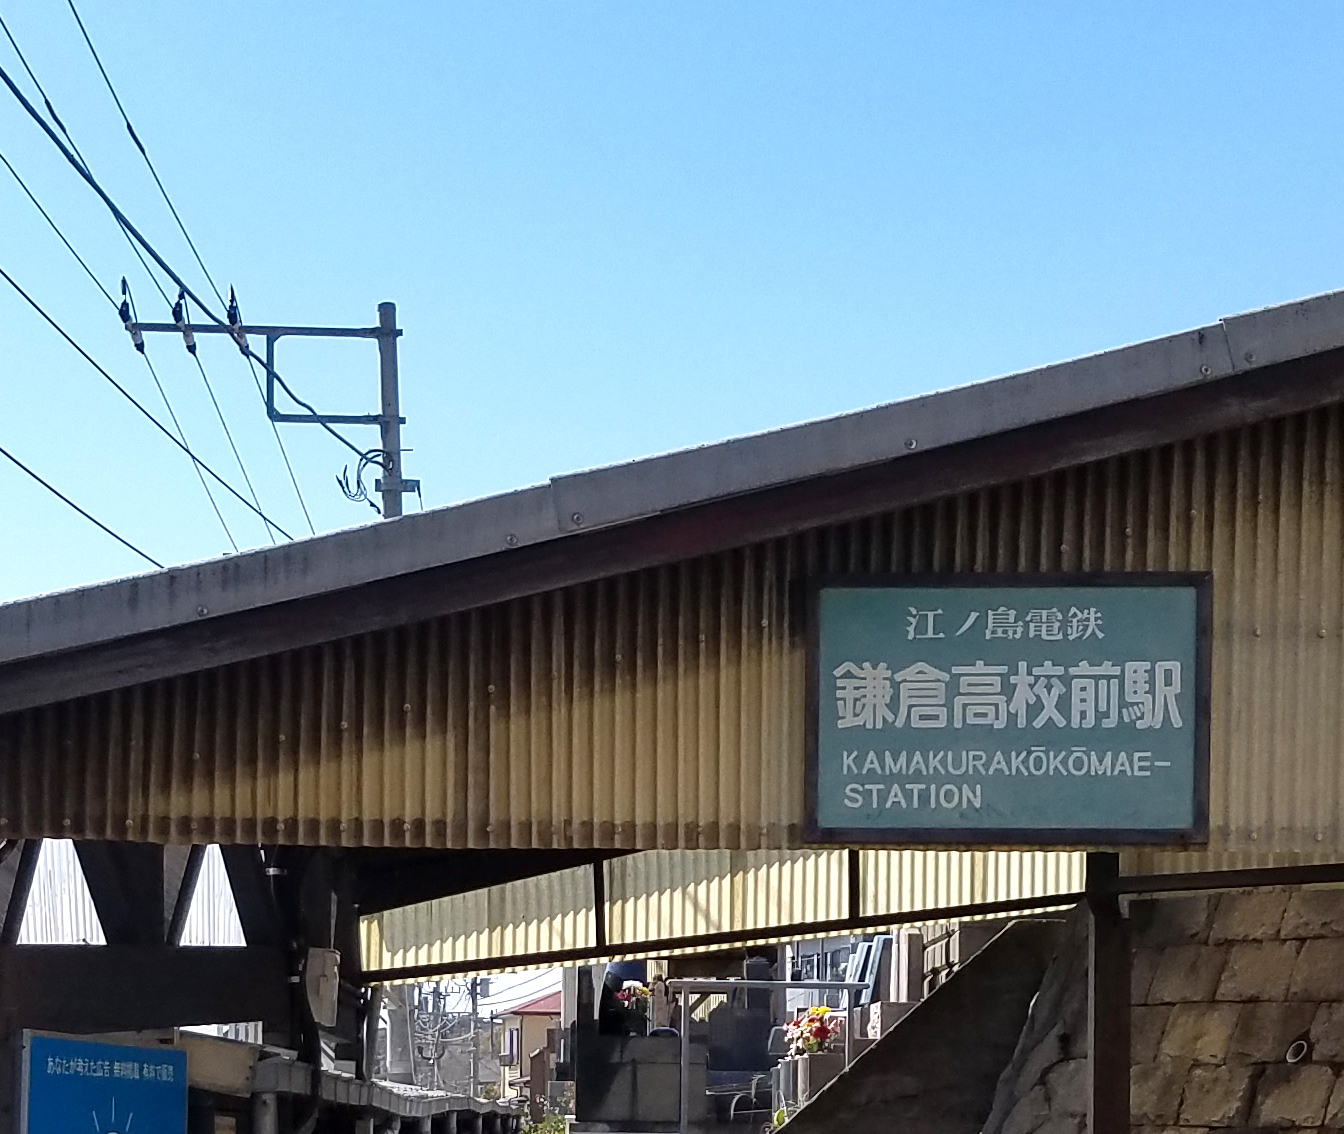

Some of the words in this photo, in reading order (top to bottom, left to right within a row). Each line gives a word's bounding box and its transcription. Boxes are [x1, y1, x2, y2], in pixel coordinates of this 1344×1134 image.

[906, 607, 1105, 640] 江ノ島電鉄
[833, 660, 1183, 729] 鎌倉高校前駅
[844, 784, 981, 809] STATION
